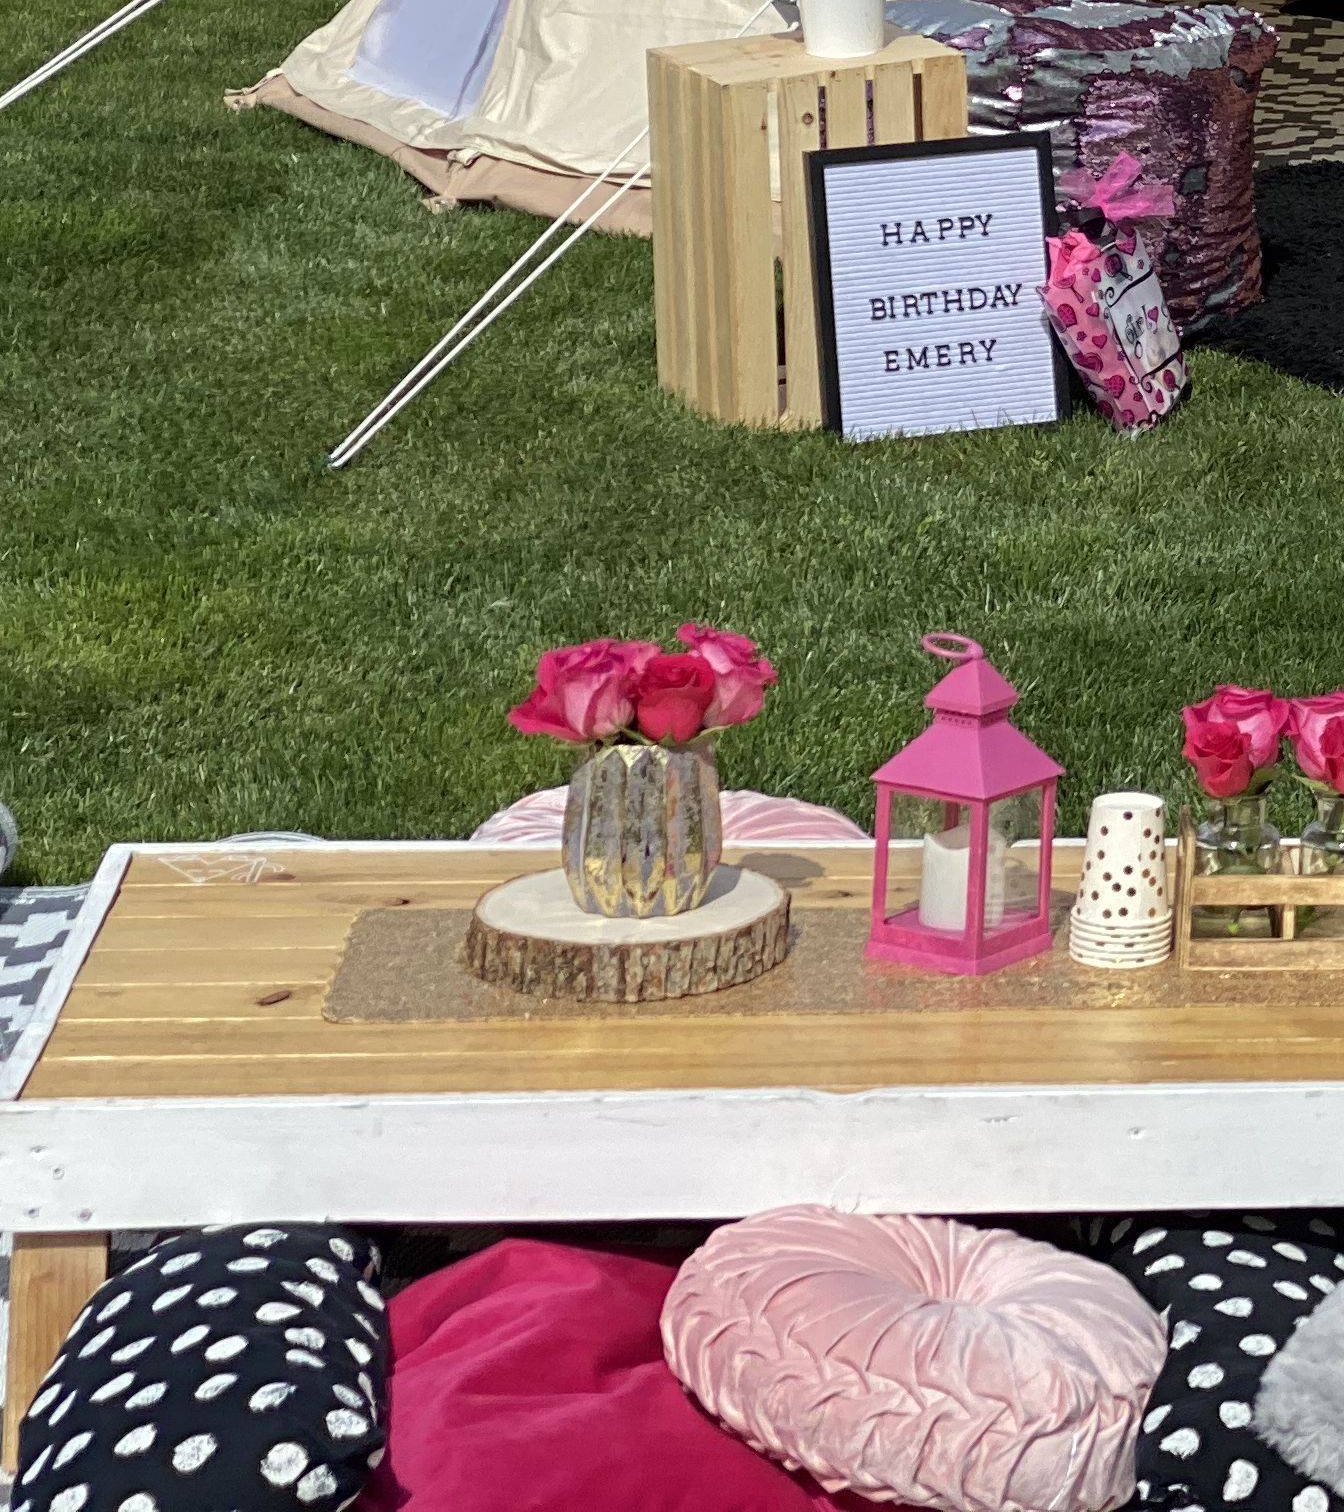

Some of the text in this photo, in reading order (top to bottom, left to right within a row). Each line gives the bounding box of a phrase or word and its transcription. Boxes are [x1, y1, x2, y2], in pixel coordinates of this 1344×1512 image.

[880, 213, 994, 246] HAPPY
[868, 283, 1023, 321] BIRTHDAY
[882, 338, 998, 372] EMERY
